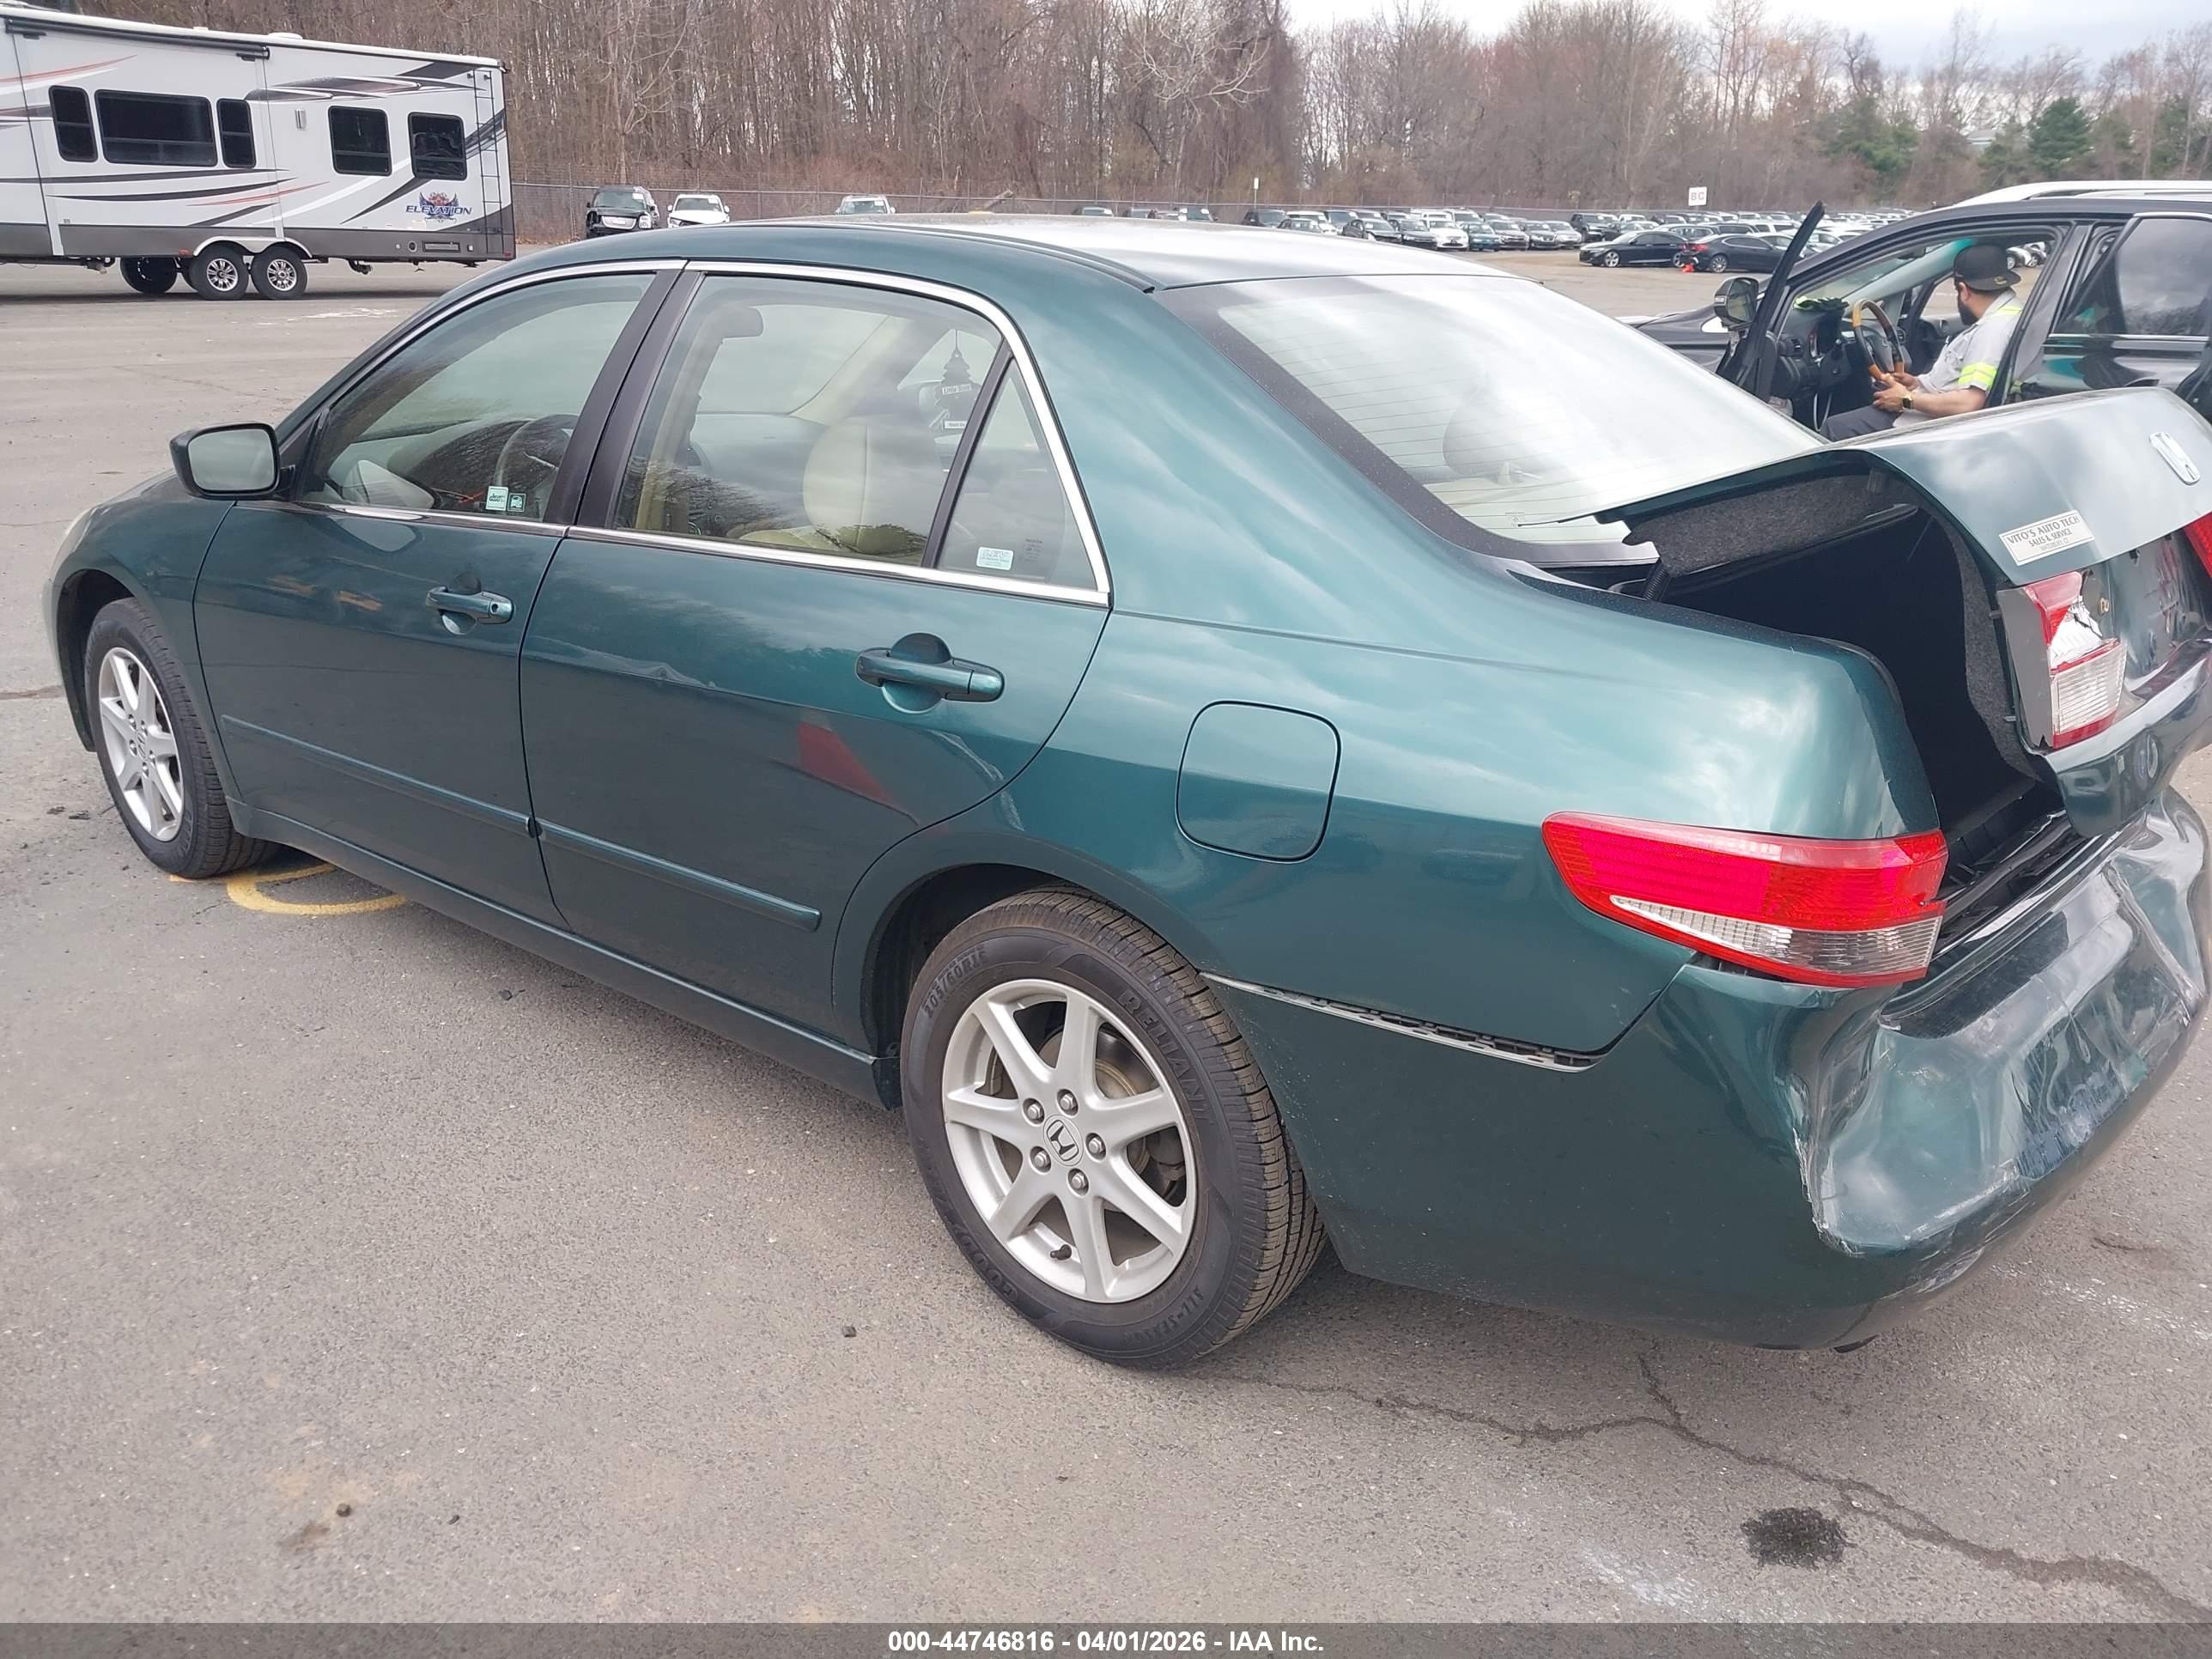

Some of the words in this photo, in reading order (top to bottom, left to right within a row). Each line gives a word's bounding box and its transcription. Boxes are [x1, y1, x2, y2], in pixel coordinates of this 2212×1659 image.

[1691, 191, 1705, 201] BC
[405, 205, 472, 215] ELEVATION
[2007, 529, 2036, 544] VITO'S
[2037, 521, 2060, 535] AUTO
[2061, 515, 2081, 527] TECH
[2028, 536, 2046, 547] SALES
[2051, 527, 2072, 540] SERVICE
[1117, 989, 1210, 1120] RELIANT
